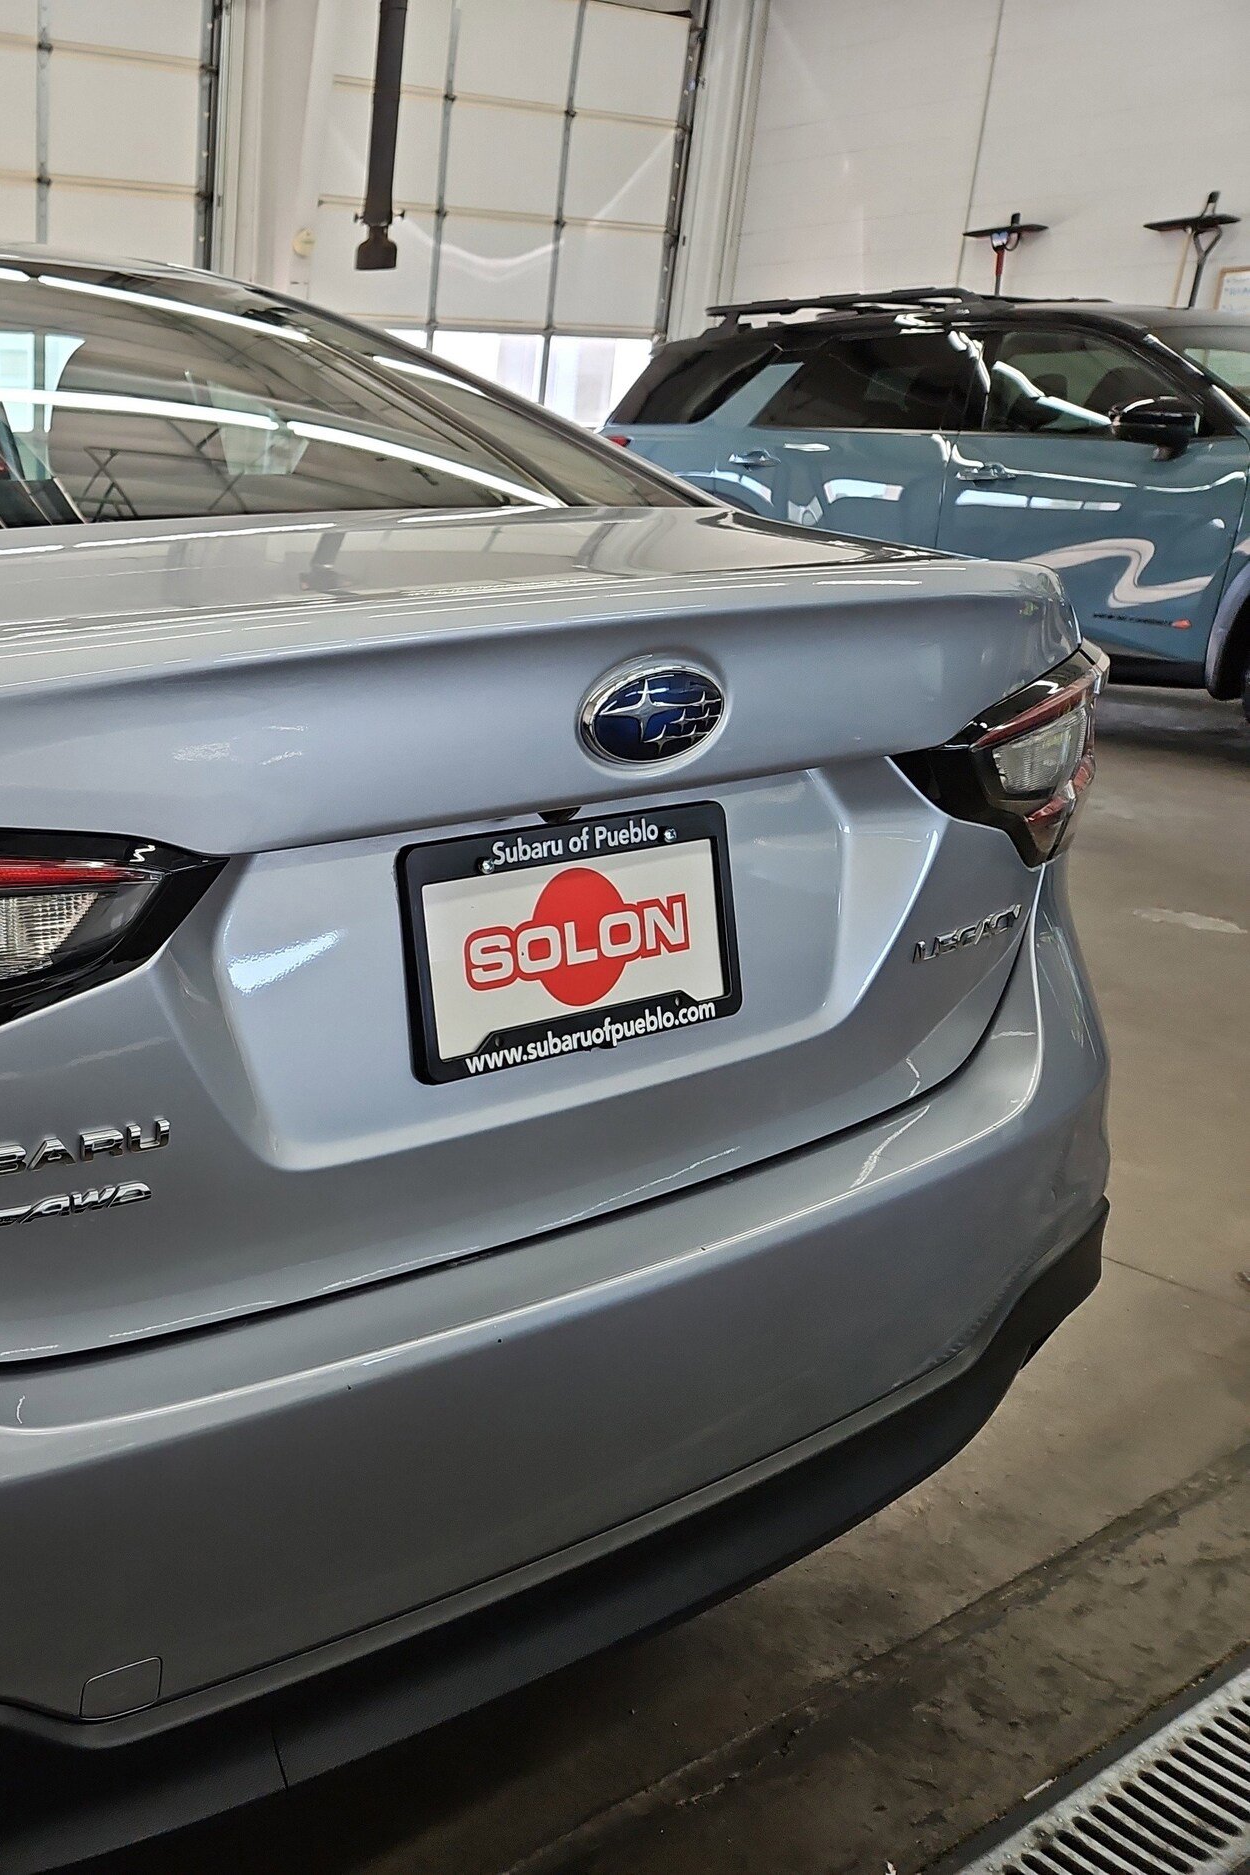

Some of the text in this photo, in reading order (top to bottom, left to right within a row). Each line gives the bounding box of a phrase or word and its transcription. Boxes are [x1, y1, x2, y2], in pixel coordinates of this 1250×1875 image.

[492, 818, 659, 866] Subaru of Pueblo
[464, 893, 691, 991] SOLON
[465, 1001, 716, 1074] www.subaruofpueblo.com
[19, 1180, 152, 1225] AWD
